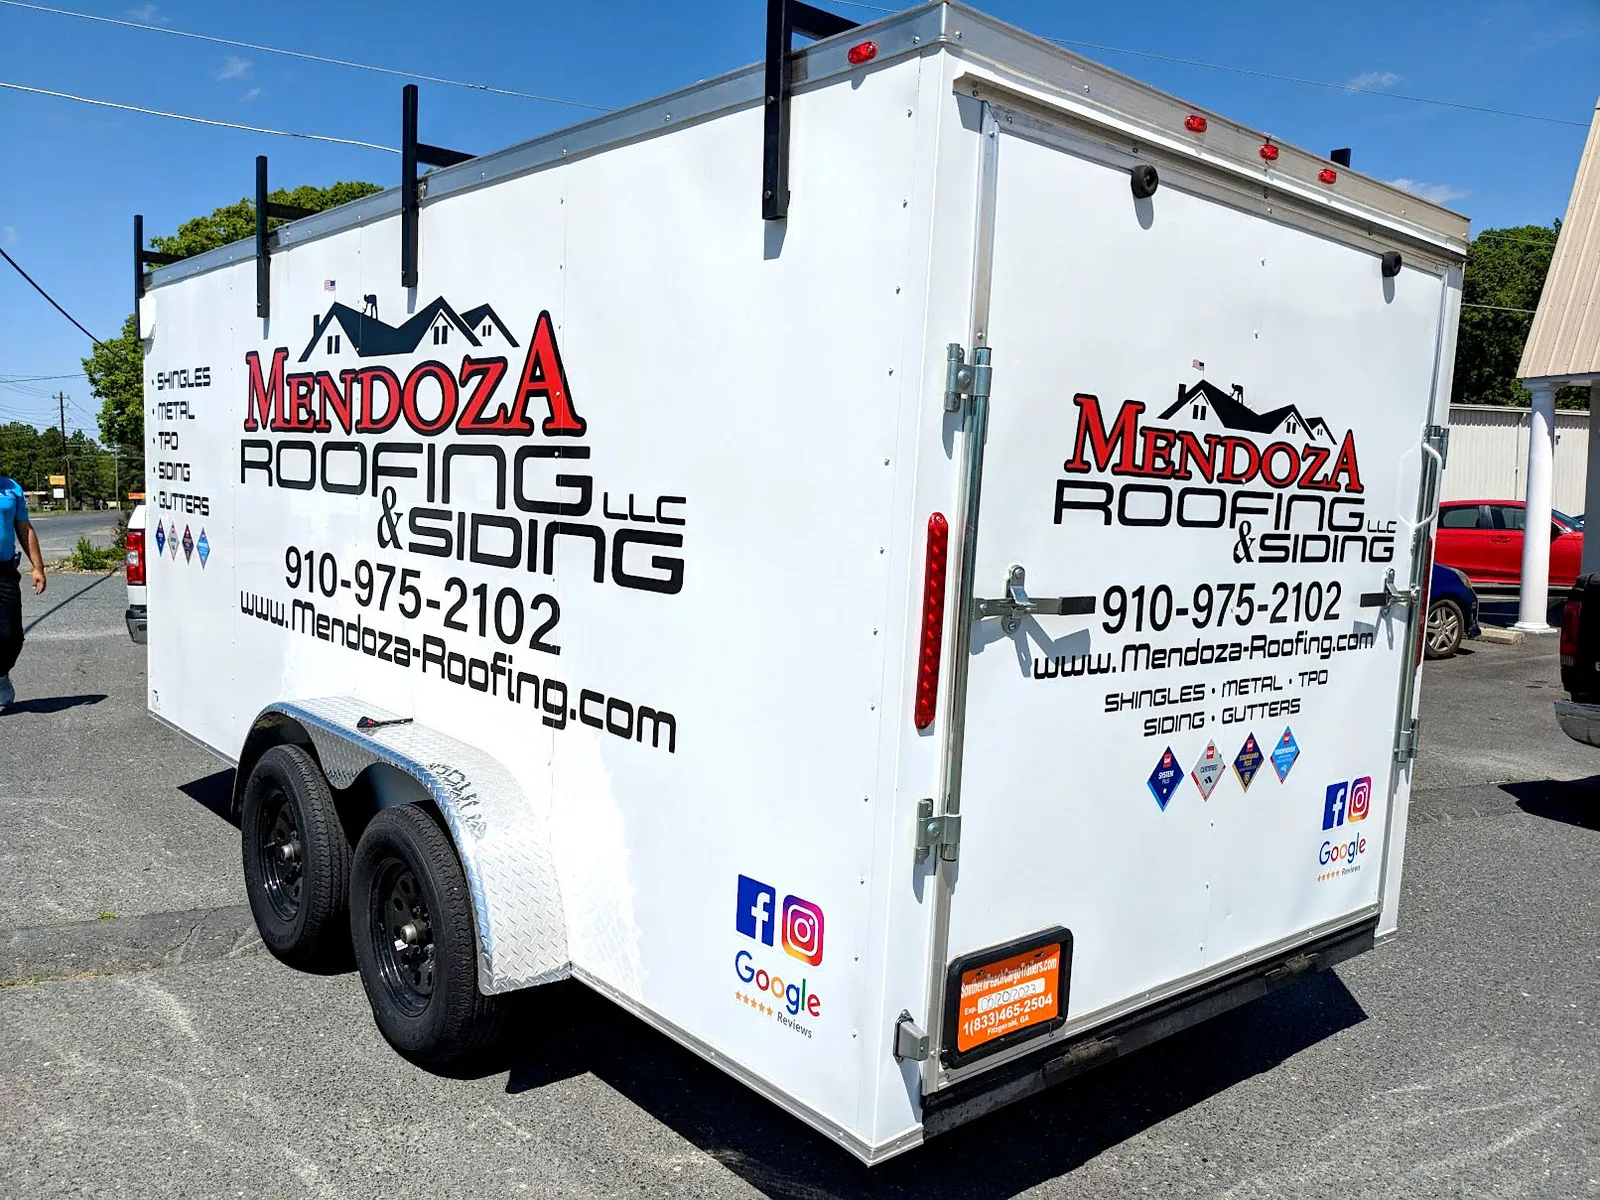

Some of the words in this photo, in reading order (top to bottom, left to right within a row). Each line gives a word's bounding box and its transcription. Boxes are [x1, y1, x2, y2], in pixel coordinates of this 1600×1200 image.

[157, 366, 211, 390] SHINGLES
[243, 308, 588, 438] MENDOZA
[158, 400, 196, 420] METAL
[158, 431, 179, 451] TPO
[1063, 392, 1365, 494] MENDOZA
[158, 461, 191, 482] SIDING
[240, 438, 592, 517] ROOFING
[602, 491, 688, 527] LLC
[159, 490, 210, 517] GUTTERS
[1053, 478, 1367, 534] ROOFING
[1367, 519, 1398, 535] LLC
[285, 545, 562, 656] 910-975-2102
[1102, 580, 1343, 635] 910-975-2102
[240, 590, 678, 755] www.Mendoza-Roofing.com
[1033, 630, 1375, 681] www.Mendoza-Roofing.com
[1104, 683, 1206, 713] SHINGLES
[1221, 674, 1283, 698] METAL
[1298, 669, 1329, 688] TPO
[1143, 710, 1206, 738] SIDING
[1221, 697, 1302, 725] GUTTERS
[1319, 832, 1366, 866] Google
[1341, 865, 1361, 877] Reviews
[735, 950, 822, 1017] Google
[777, 1011, 812, 1039] Reviews
[963, 992, 1053, 1036] 1(833)465-2504
